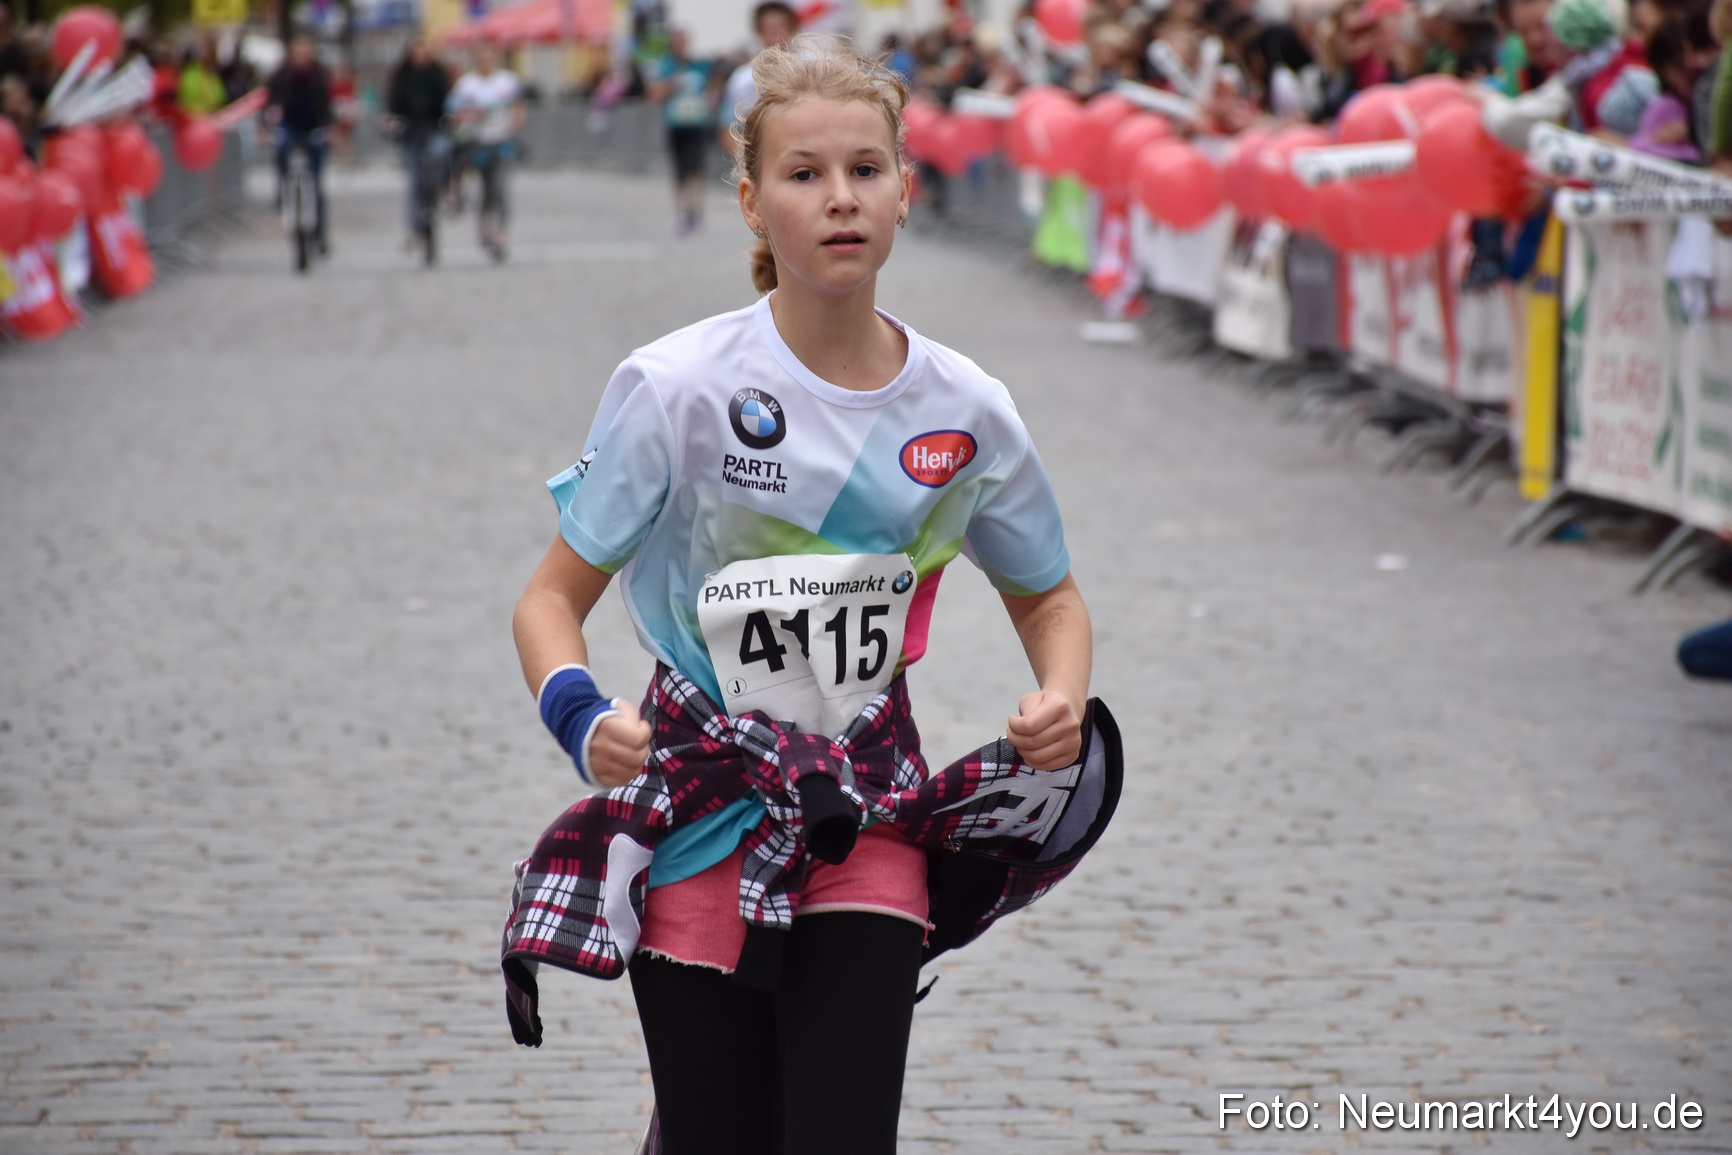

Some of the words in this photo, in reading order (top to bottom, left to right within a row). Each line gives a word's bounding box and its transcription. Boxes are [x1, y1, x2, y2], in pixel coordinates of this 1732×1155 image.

[735, 389, 780, 414] BMW
[723, 453, 788, 480] PARTL
[722, 470, 787, 494] Neumarkt
[704, 579, 783, 604] PARTL
[789, 575, 886, 596] Neumarkt
[738, 604, 890, 686] 4115
